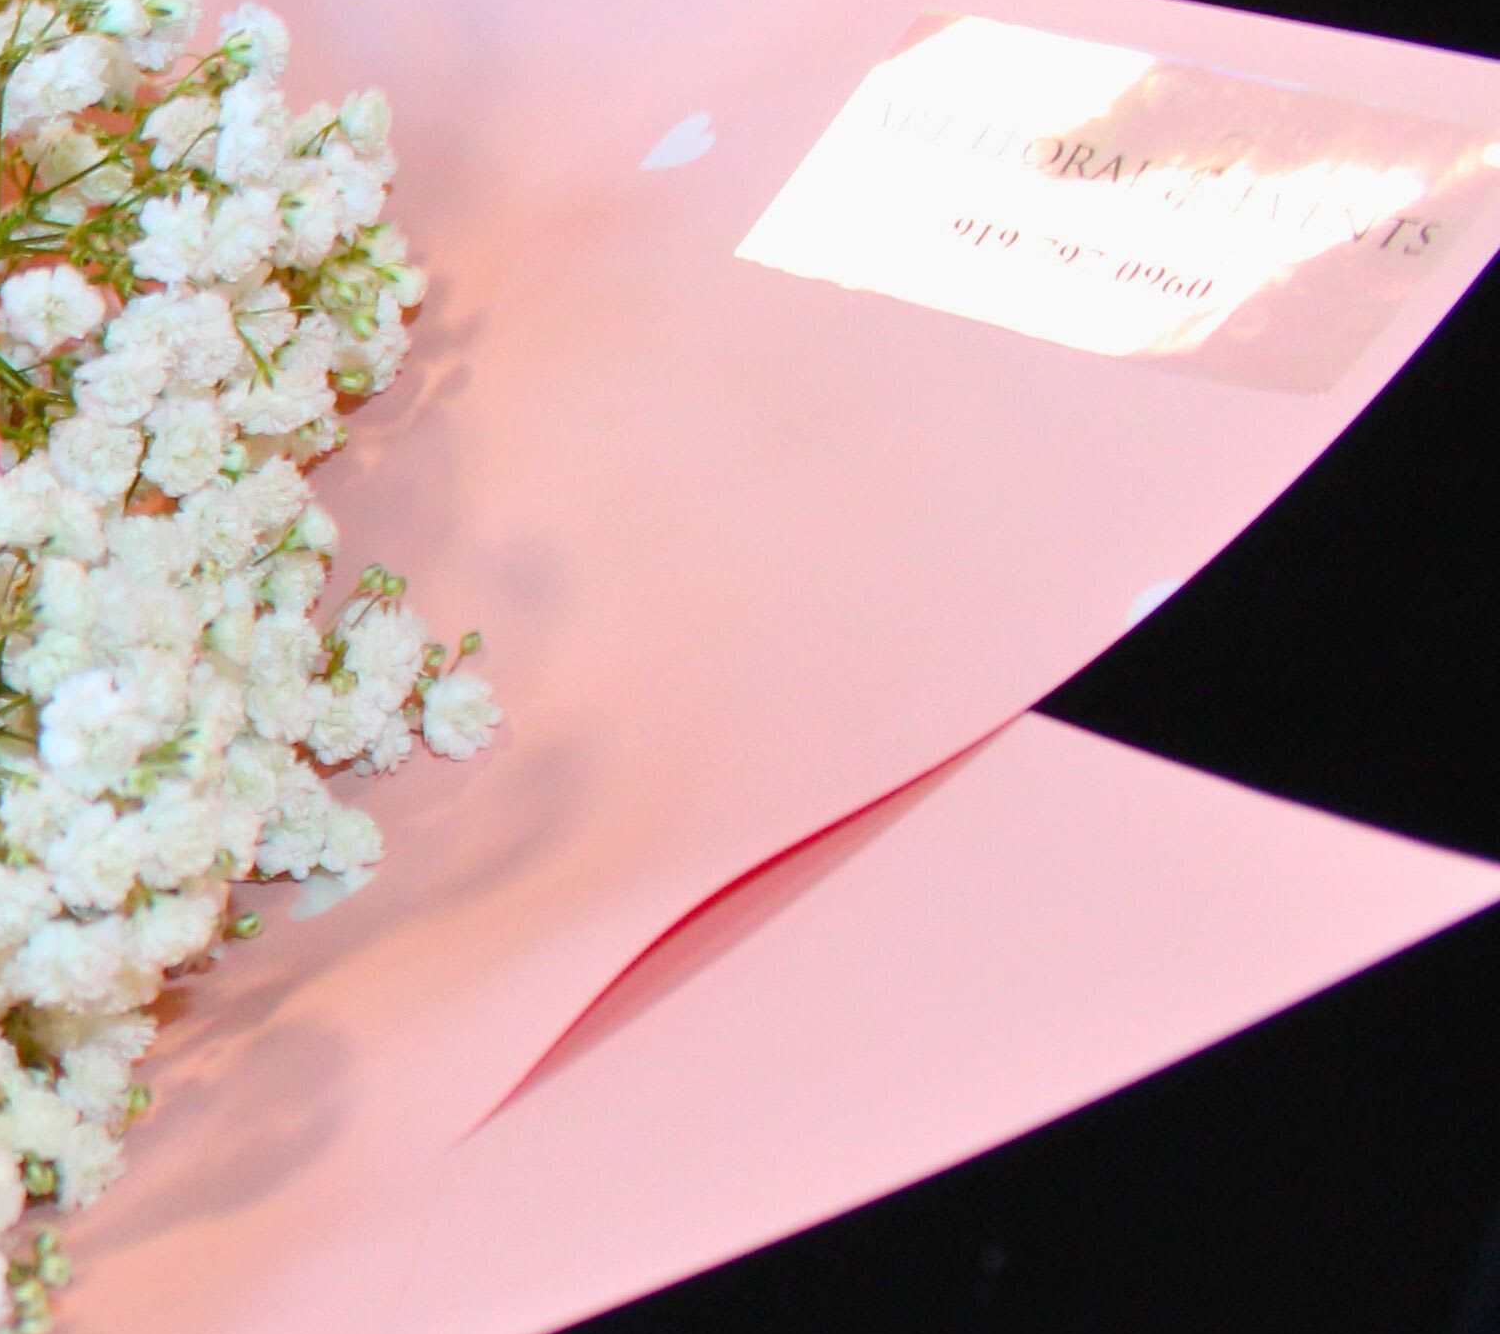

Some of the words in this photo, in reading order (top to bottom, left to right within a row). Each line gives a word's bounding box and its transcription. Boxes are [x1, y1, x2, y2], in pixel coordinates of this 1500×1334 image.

[971, 123, 1154, 187] ORA
[954, 217, 1019, 249] 919
[1114, 260, 1214, 300] 0960
